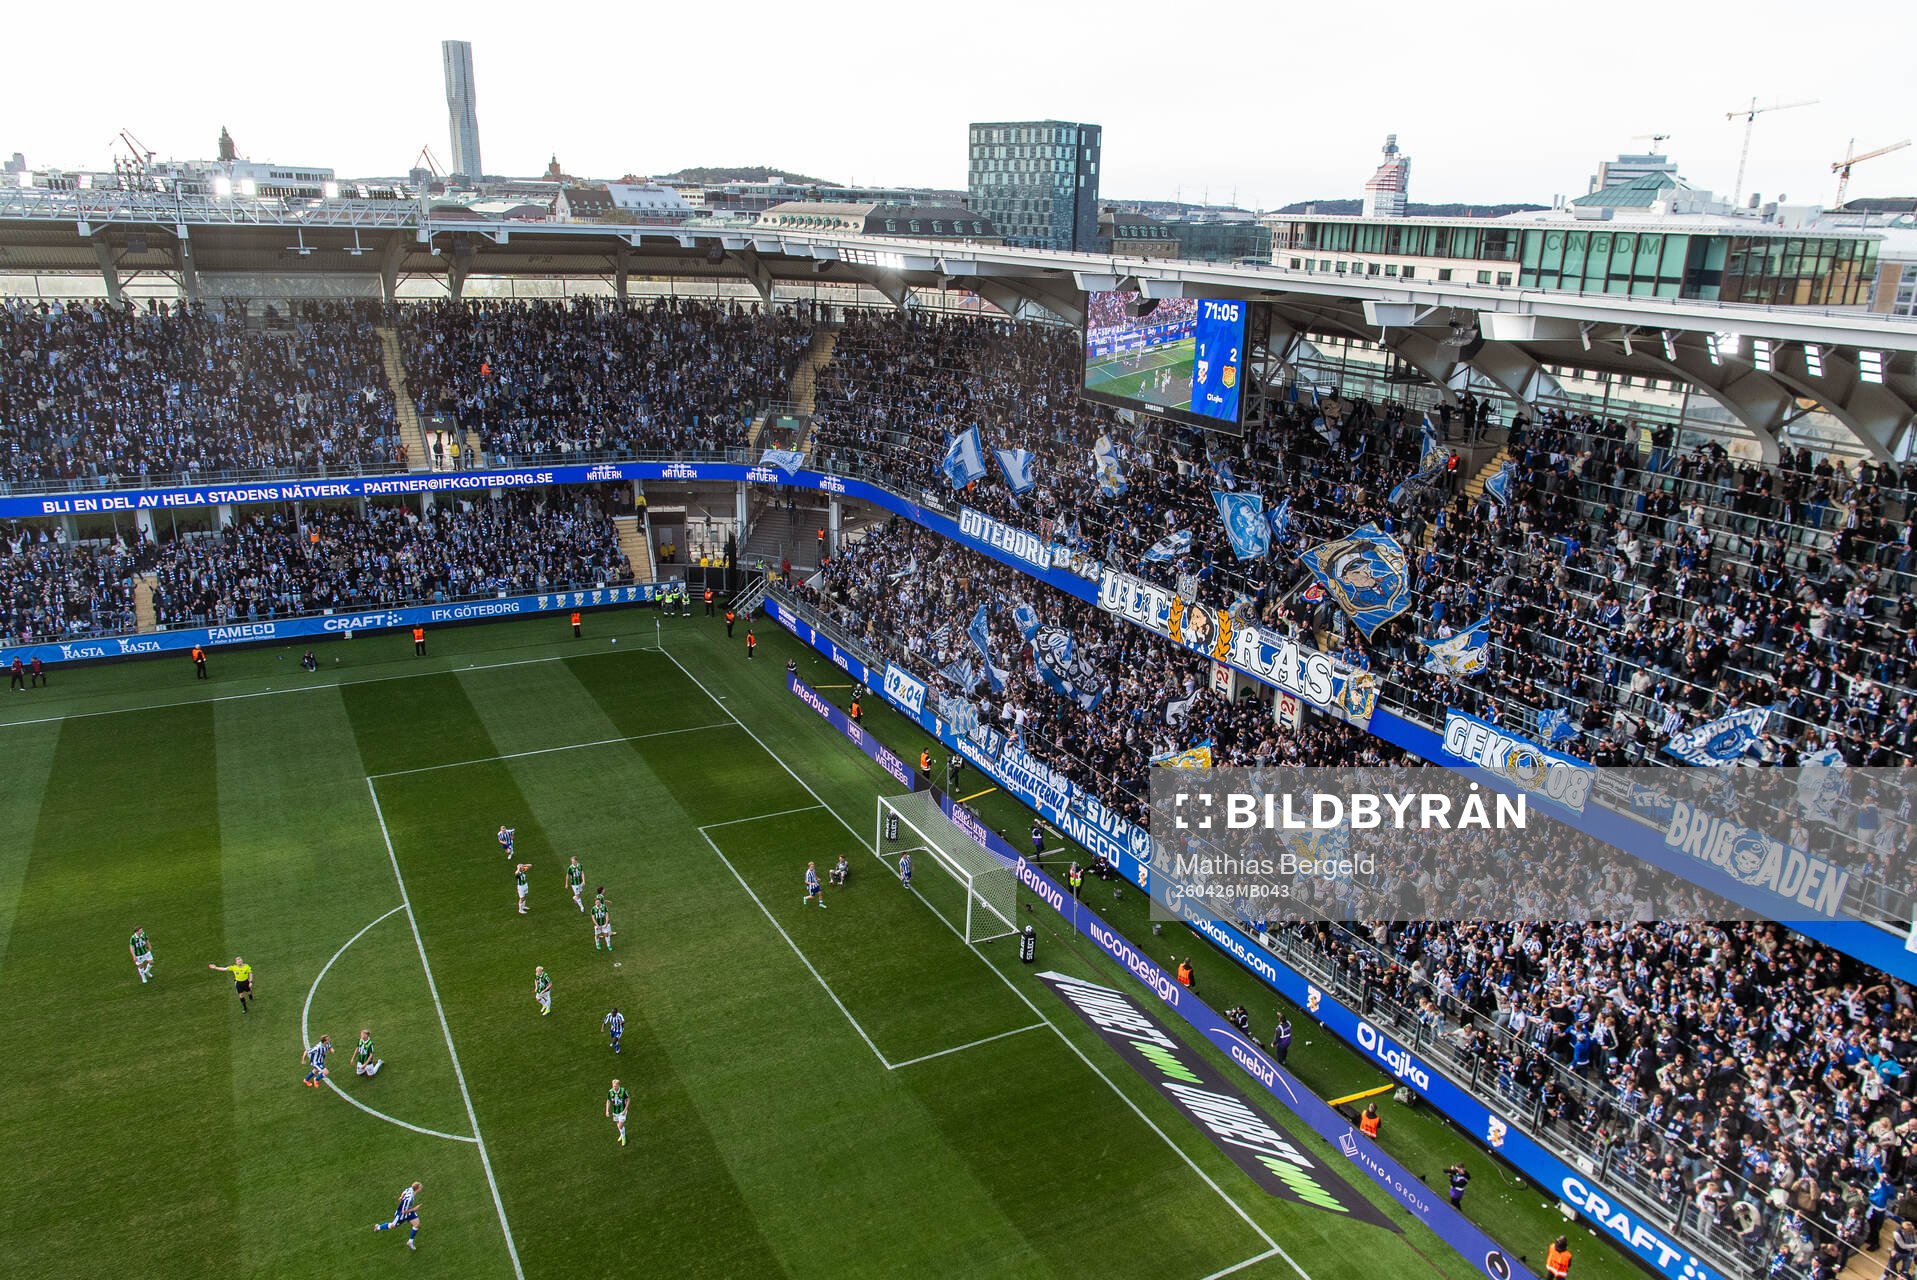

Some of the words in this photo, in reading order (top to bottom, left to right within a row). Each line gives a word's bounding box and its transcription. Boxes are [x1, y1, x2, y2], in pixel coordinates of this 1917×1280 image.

[1546, 233, 1661, 257] CONVENDUM
[1204, 302, 1239, 322] 71:05
[1200, 344, 1206, 357] 1
[1230, 348, 1237, 362] 2
[43, 500, 72, 514] BLI
[74, 498, 99, 511] EN
[102, 497, 136, 510] DEL
[138, 495, 159, 508] AV
[162, 493, 205, 506] HELA
[208, 488, 279, 504] STADENS
[282, 484, 351, 500] NÄTVERK
[364, 472, 553, 494] PARTNER@IFKGOTEBORG.SE
[324, 615, 385, 631] CRAFT
[431, 607, 451, 621] IFK
[454, 601, 520, 618] GÖTEBORG
[208, 623, 275, 640] FAMECO
[64, 647, 104, 660] RASTA
[120, 641, 161, 653] RASTA
[832, 651, 849, 671] RASTA
[792, 678, 830, 718] Interbus
[875, 752, 908, 786] WELLNESS
[880, 746, 903, 771] NORDIC
[1446, 717, 1512, 775] GFK
[1545, 767, 1589, 808] 08
[1000, 757, 1066, 811] KAMRATERNA
[1016, 856, 1063, 912] Renova
[1184, 902, 1277, 982] bookabus.com
[1231, 1044, 1274, 1088] cuebid
[1360, 1151, 1392, 1185] VINGA
[1395, 1183, 1430, 1215] GROUP
[1561, 1176, 1682, 1268] CRAFT
